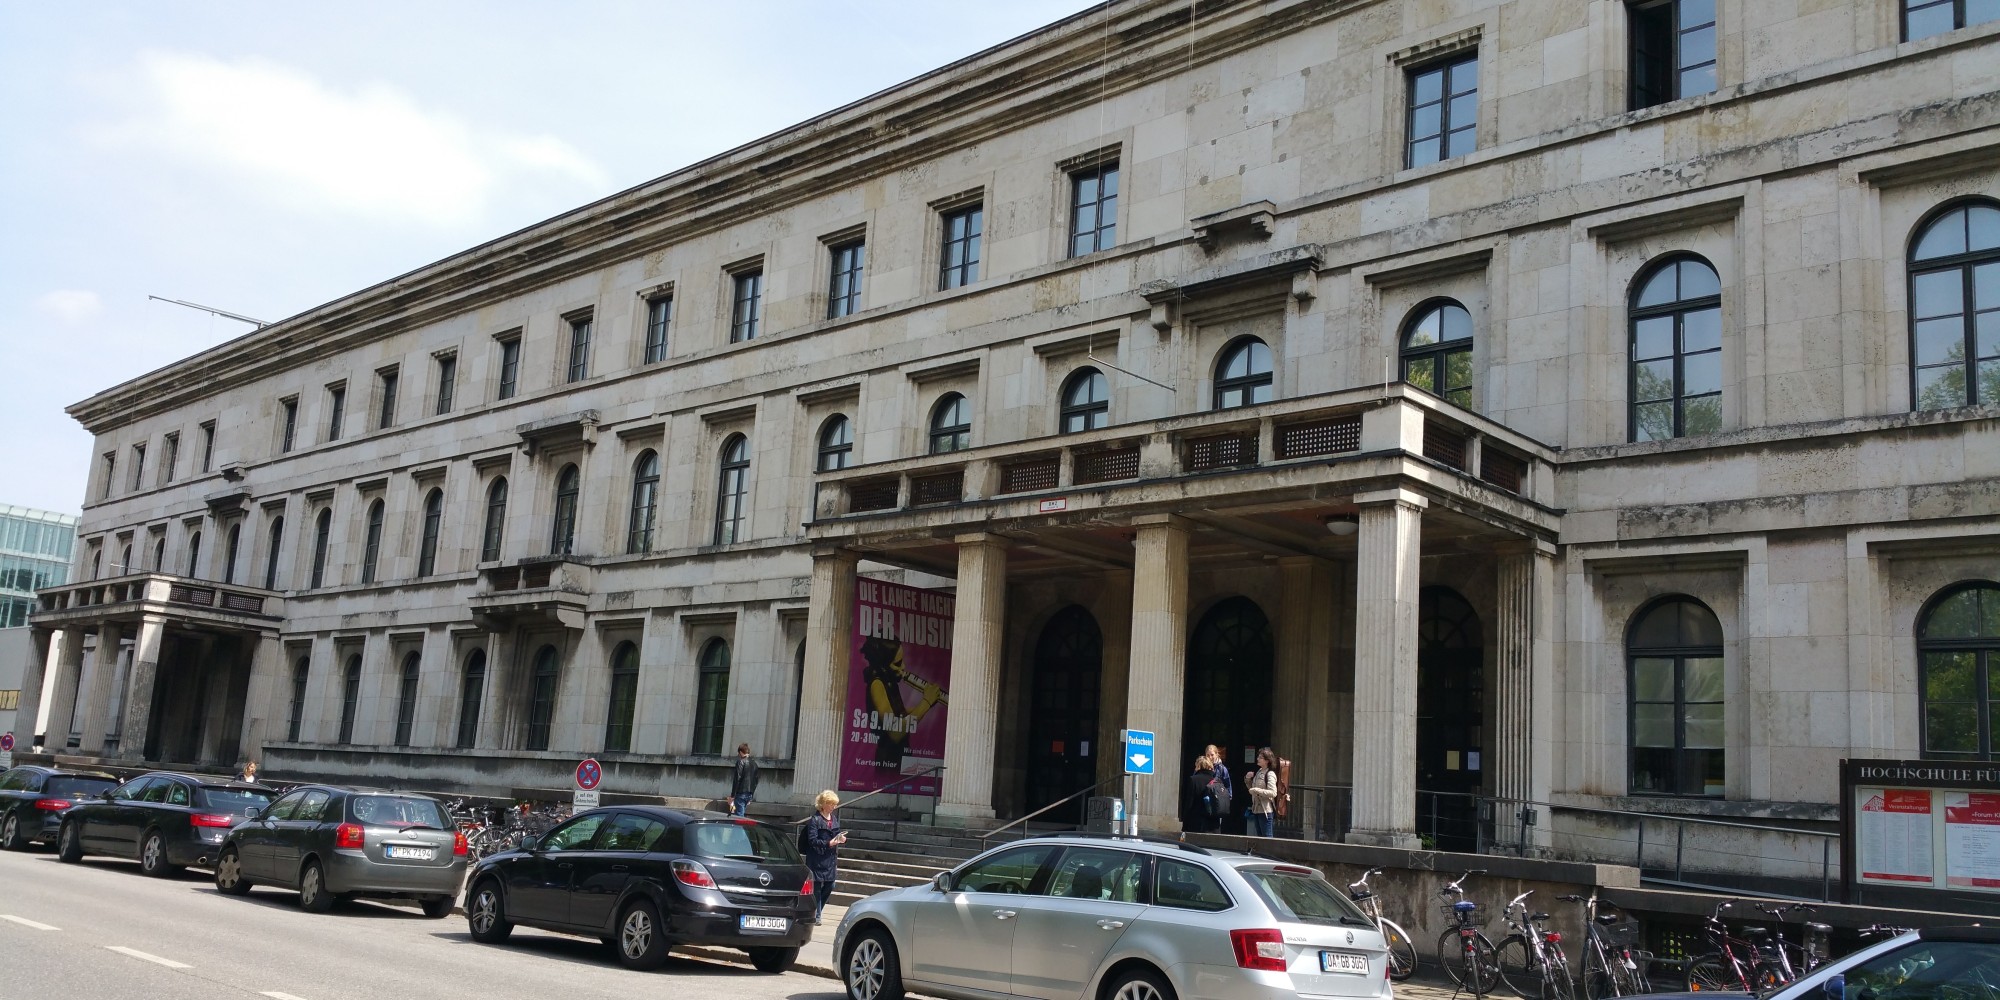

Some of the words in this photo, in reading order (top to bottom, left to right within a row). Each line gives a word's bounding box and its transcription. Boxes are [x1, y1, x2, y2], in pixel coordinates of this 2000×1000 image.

[860, 581, 878, 603] DIE
[882, 586, 917, 610] LANGE
[860, 604, 895, 640] DER
[852, 708, 868, 729] Sa
[870, 710, 881, 730] 9.
[882, 712, 903, 732] Mai
[904, 715, 918, 734] 15
[850, 731, 860, 743] 20
[1128, 735, 1153, 746] Parkschein
[855, 758, 881, 767] Karten
[882, 760, 897, 768] hier
[1861, 766, 1971, 781] HOCHSCHULE
[1976, 768, 2000, 782] FÜ
[1888, 803, 1929, 811] Veranstaltungen
